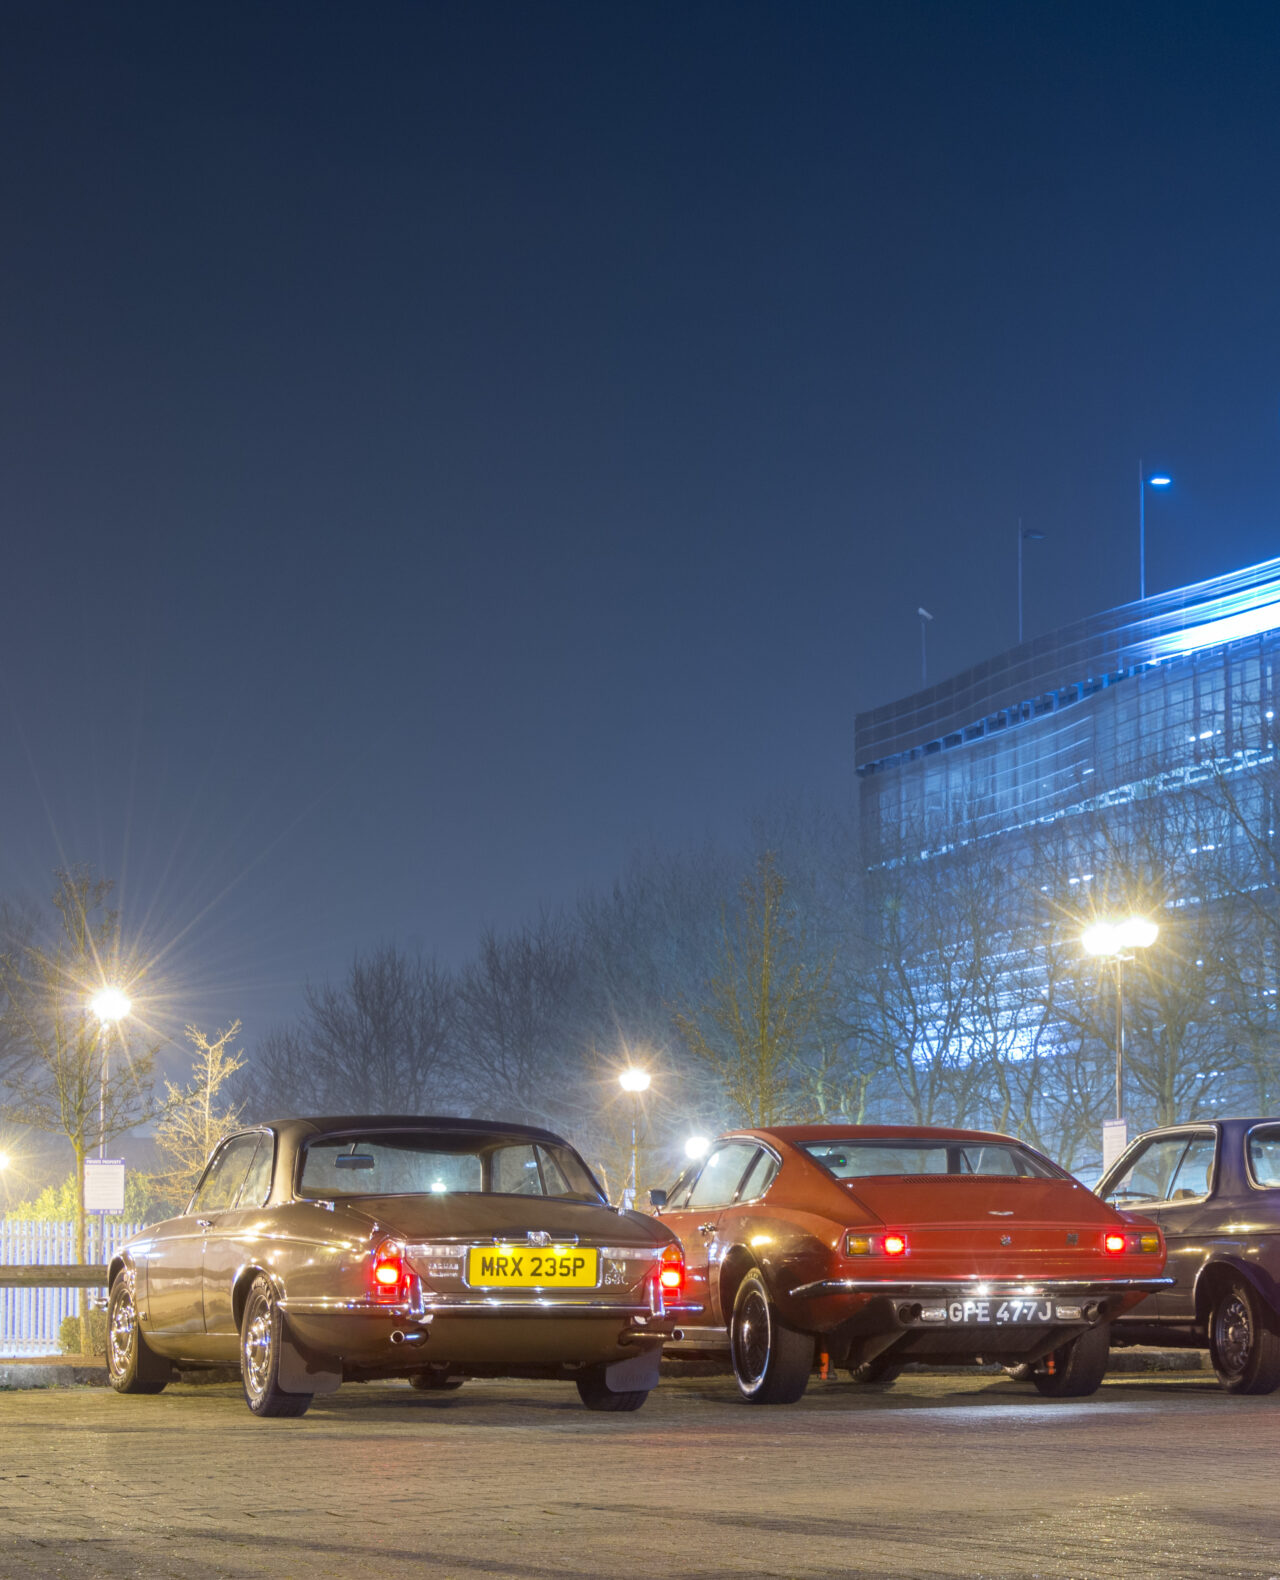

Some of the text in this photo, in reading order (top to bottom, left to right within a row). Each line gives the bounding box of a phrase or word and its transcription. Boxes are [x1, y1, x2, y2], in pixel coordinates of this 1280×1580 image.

[481, 1257, 585, 1277] MRX 235P
[949, 1301, 1051, 1322] GPE 477J
